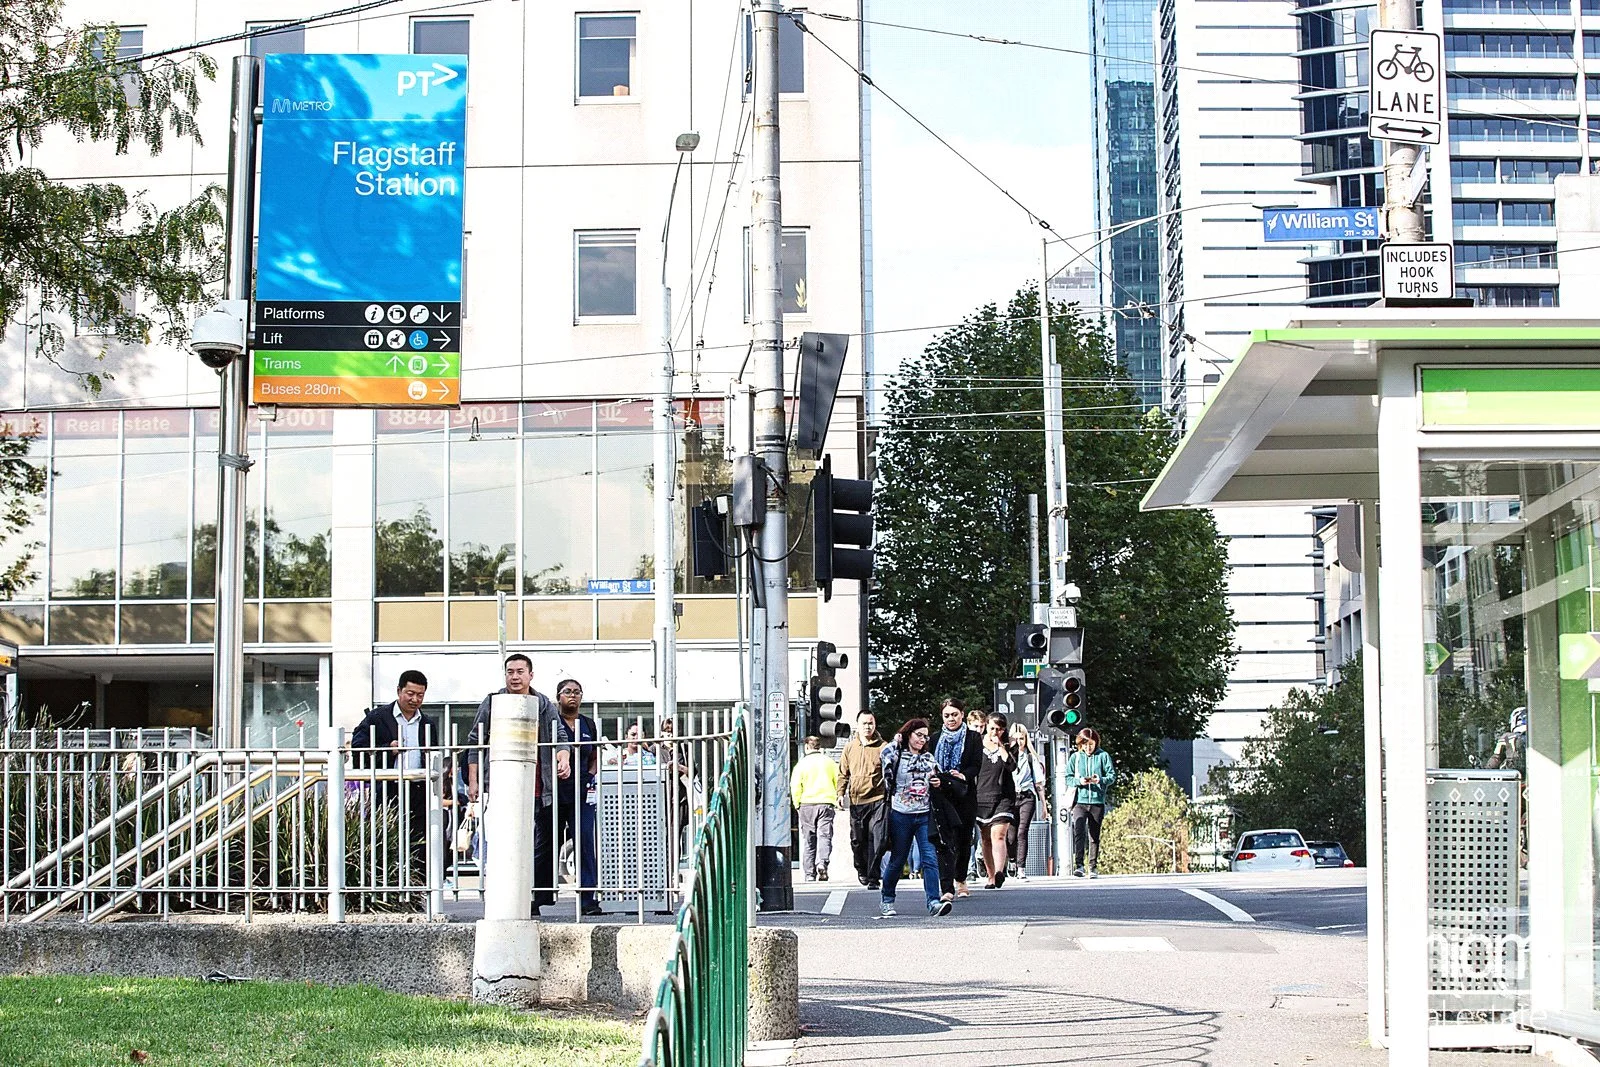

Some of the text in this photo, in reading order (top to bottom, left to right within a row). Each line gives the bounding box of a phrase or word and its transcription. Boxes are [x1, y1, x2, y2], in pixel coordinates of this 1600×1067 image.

[292, 101, 332, 111] METRO
[1377, 91, 1435, 114] LANE
[332, 141, 456, 171] Flagstaff
[354, 171, 456, 196] Station
[1281, 211, 1375, 229] William St
[1386, 251, 1447, 263] INCLUDES
[1400, 266, 1434, 278] HOOK
[1397, 282, 1439, 294] TURNS
[263, 307, 325, 319] Platforms
[262, 332, 283, 344] Lift
[262, 357, 302, 369] Trams
[261, 383, 341, 395] Buses 280m
[453, 406, 509, 425] 3001
[66, 418, 105, 433] Real
[590, 580, 620, 590] William
